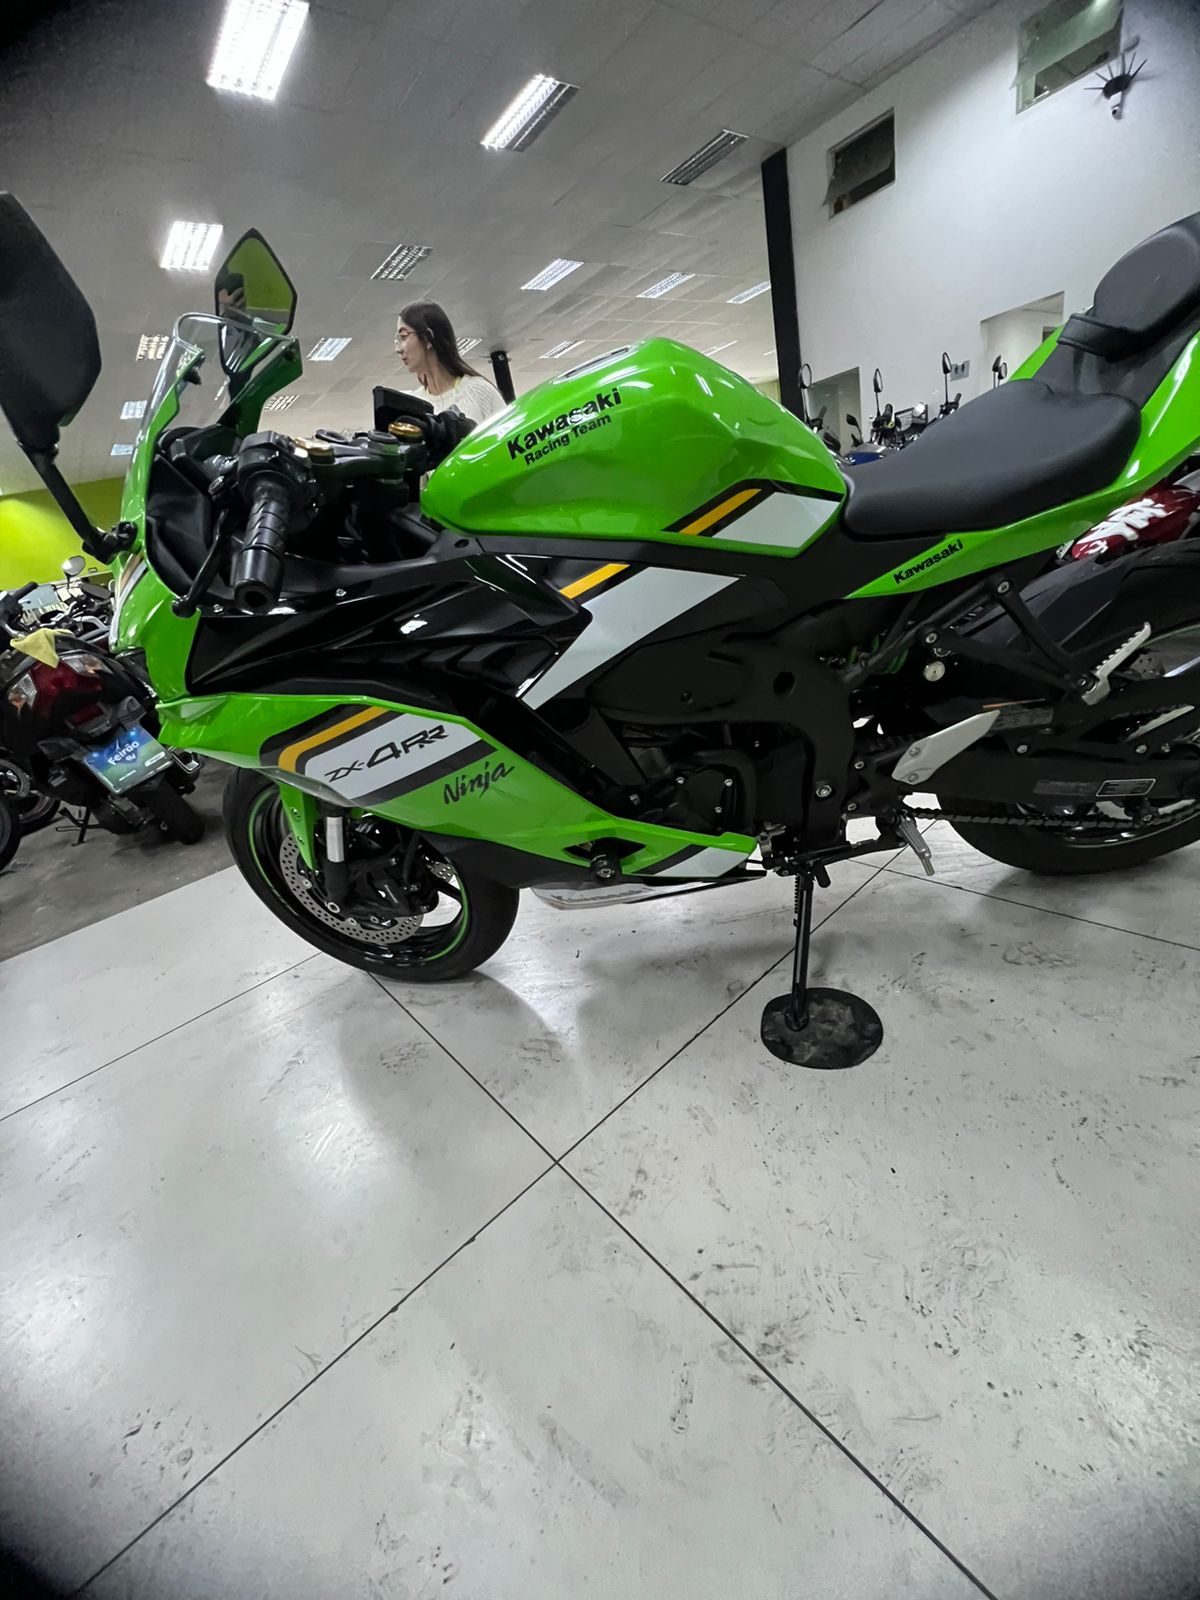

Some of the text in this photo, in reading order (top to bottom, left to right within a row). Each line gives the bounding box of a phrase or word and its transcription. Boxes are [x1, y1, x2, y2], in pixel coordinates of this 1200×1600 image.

[507, 387, 622, 460] Kawasaki
[524, 414, 611, 465] Racing Team
[893, 538, 964, 584] Kawasaki
[324, 724, 448, 782] ZX-4RR
[443, 761, 515, 805] Ninja
